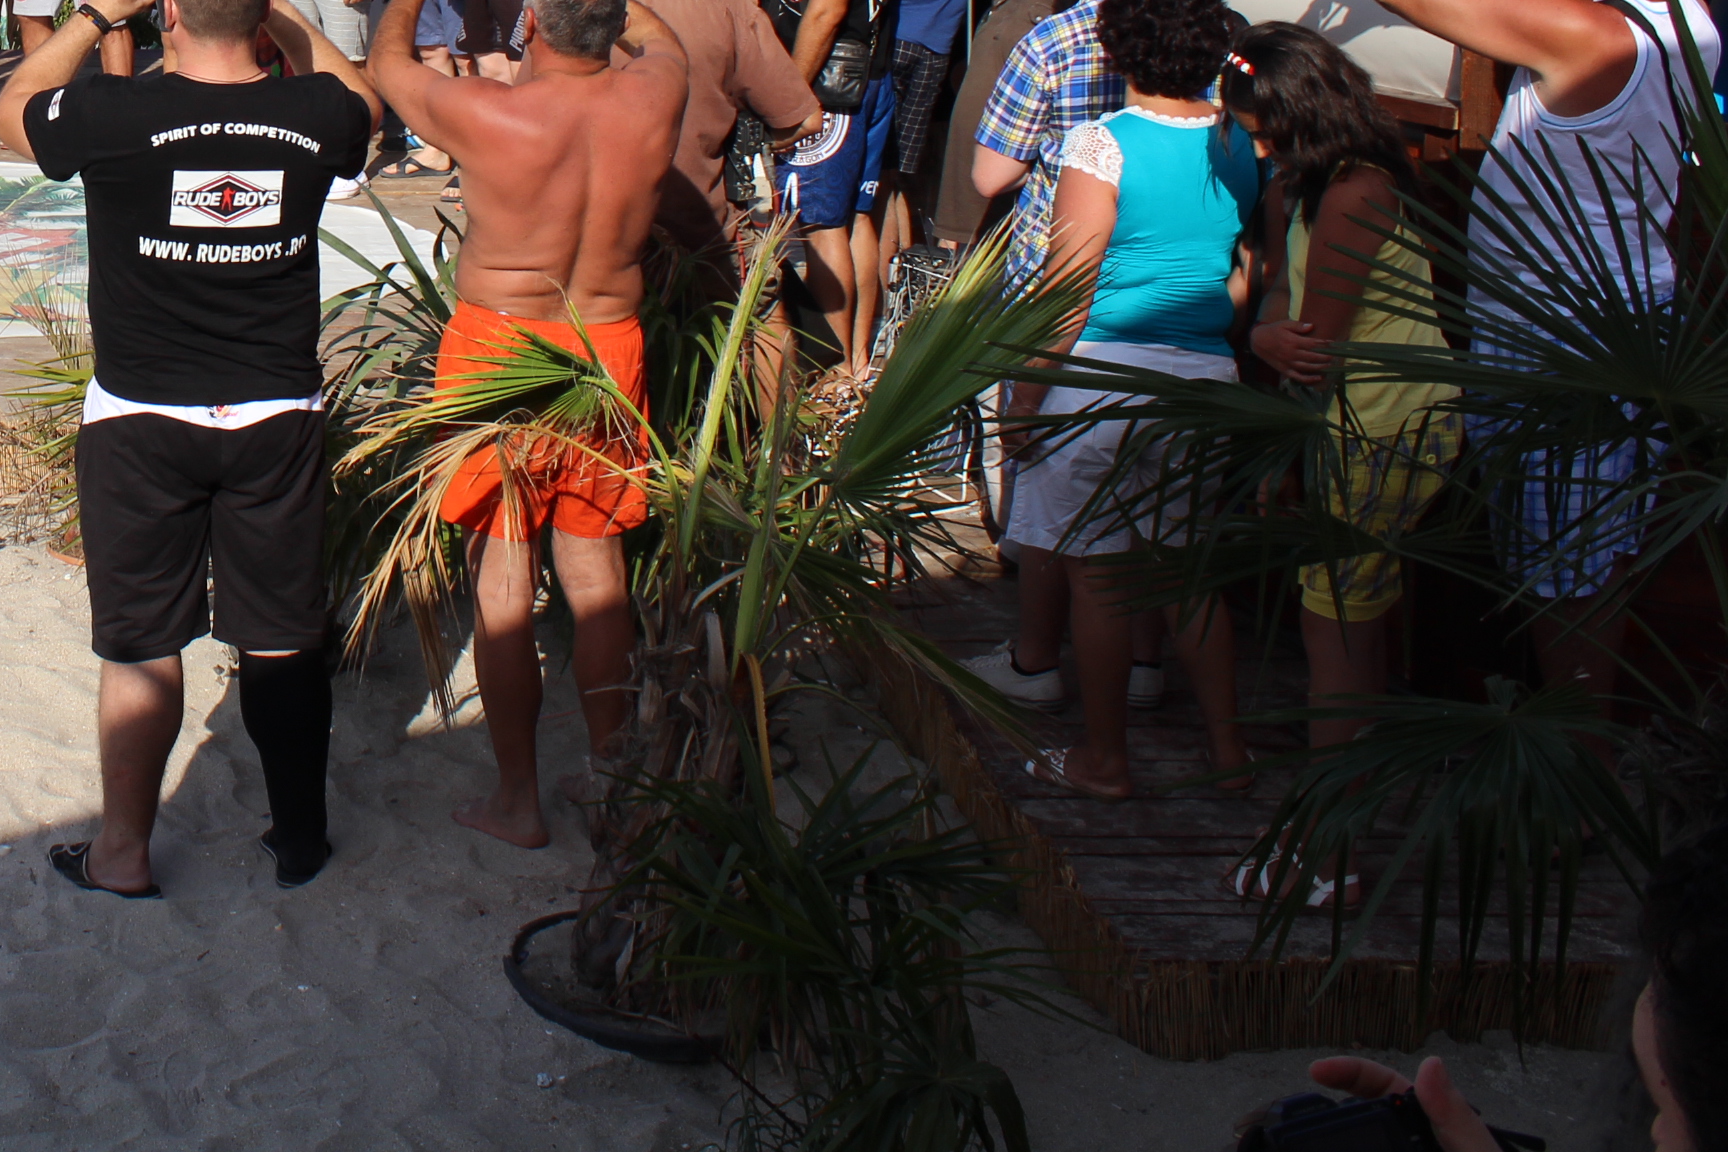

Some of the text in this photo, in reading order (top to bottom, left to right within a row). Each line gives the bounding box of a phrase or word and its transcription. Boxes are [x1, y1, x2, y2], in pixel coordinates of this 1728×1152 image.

[150, 123, 321, 154] SPIRIT OF COMPETITION
[174, 190, 279, 206] RUDE BOYS
[139, 236, 192, 261] WWW.
[196, 241, 282, 263] RUDEBOYS
